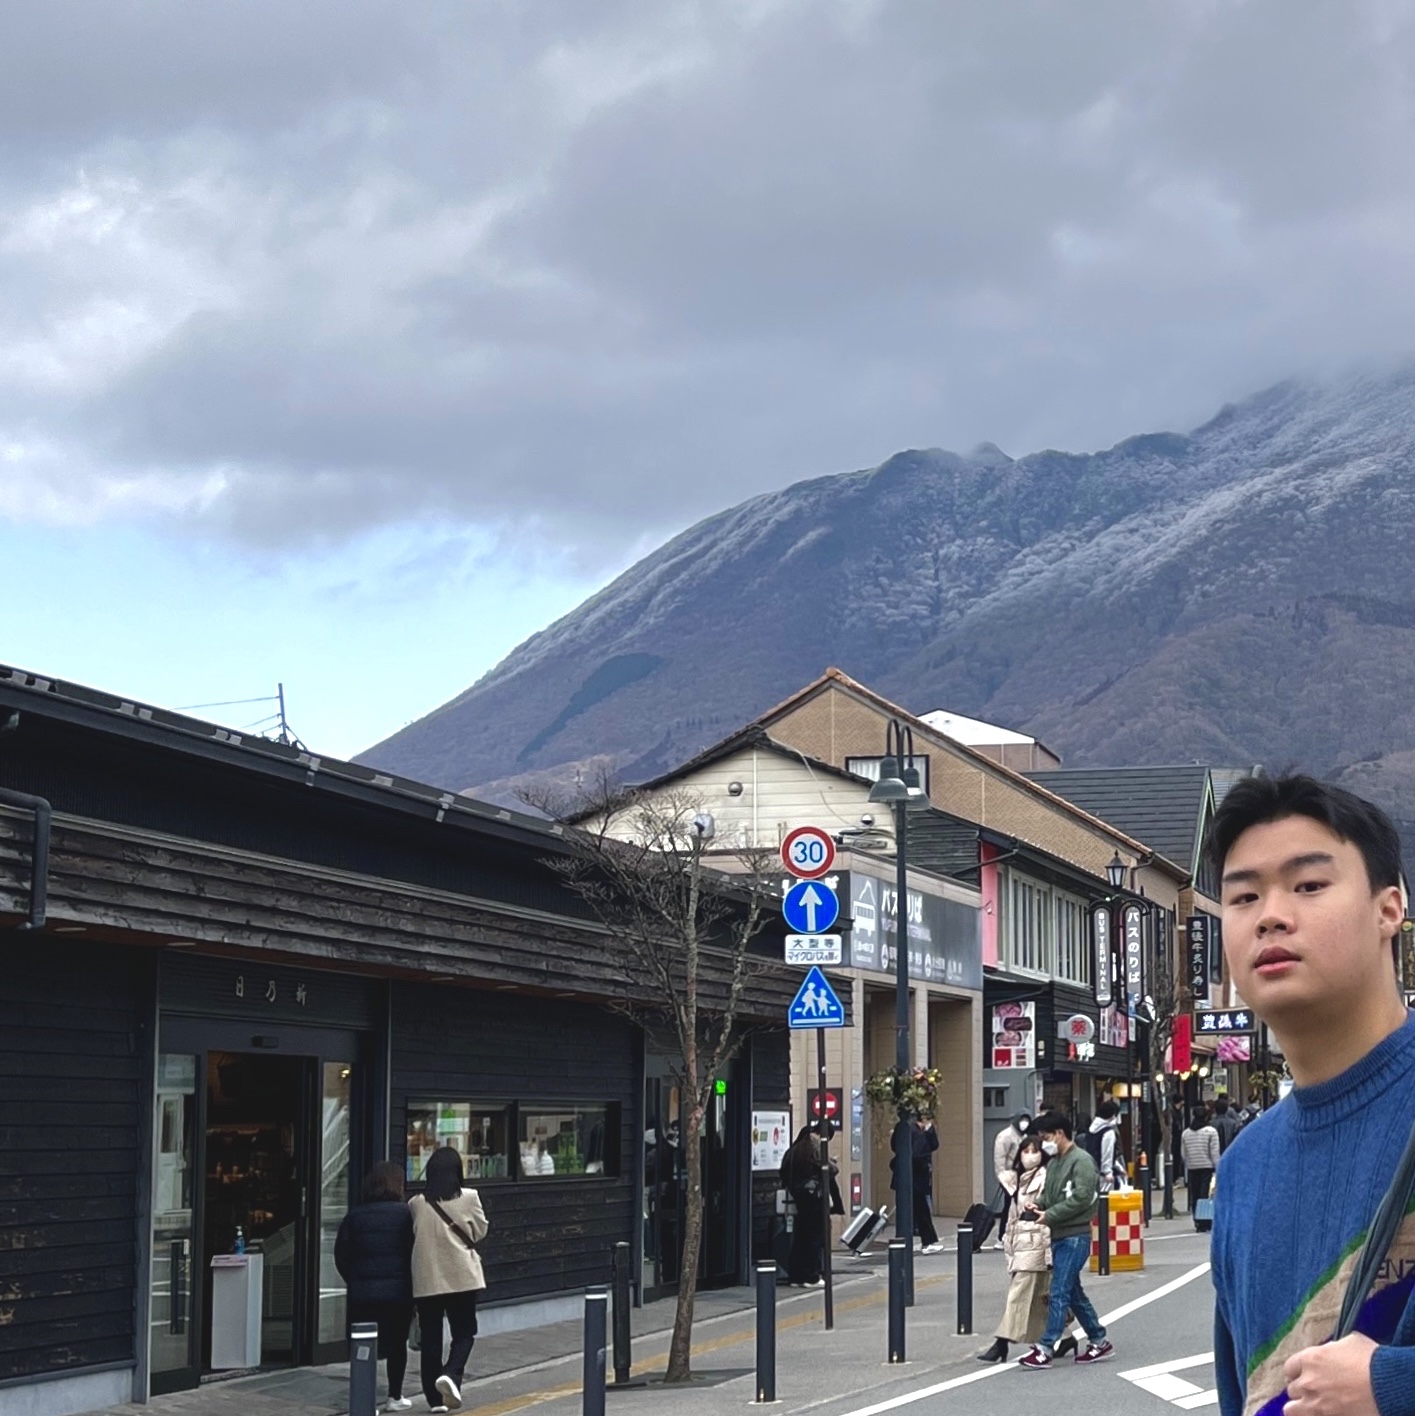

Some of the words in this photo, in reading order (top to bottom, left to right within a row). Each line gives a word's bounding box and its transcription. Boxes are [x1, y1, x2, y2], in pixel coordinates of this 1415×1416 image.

[794, 841, 823, 863] 30
[881, 889, 923, 924] バスりば
[1127, 912, 1141, 983] バスのりば
